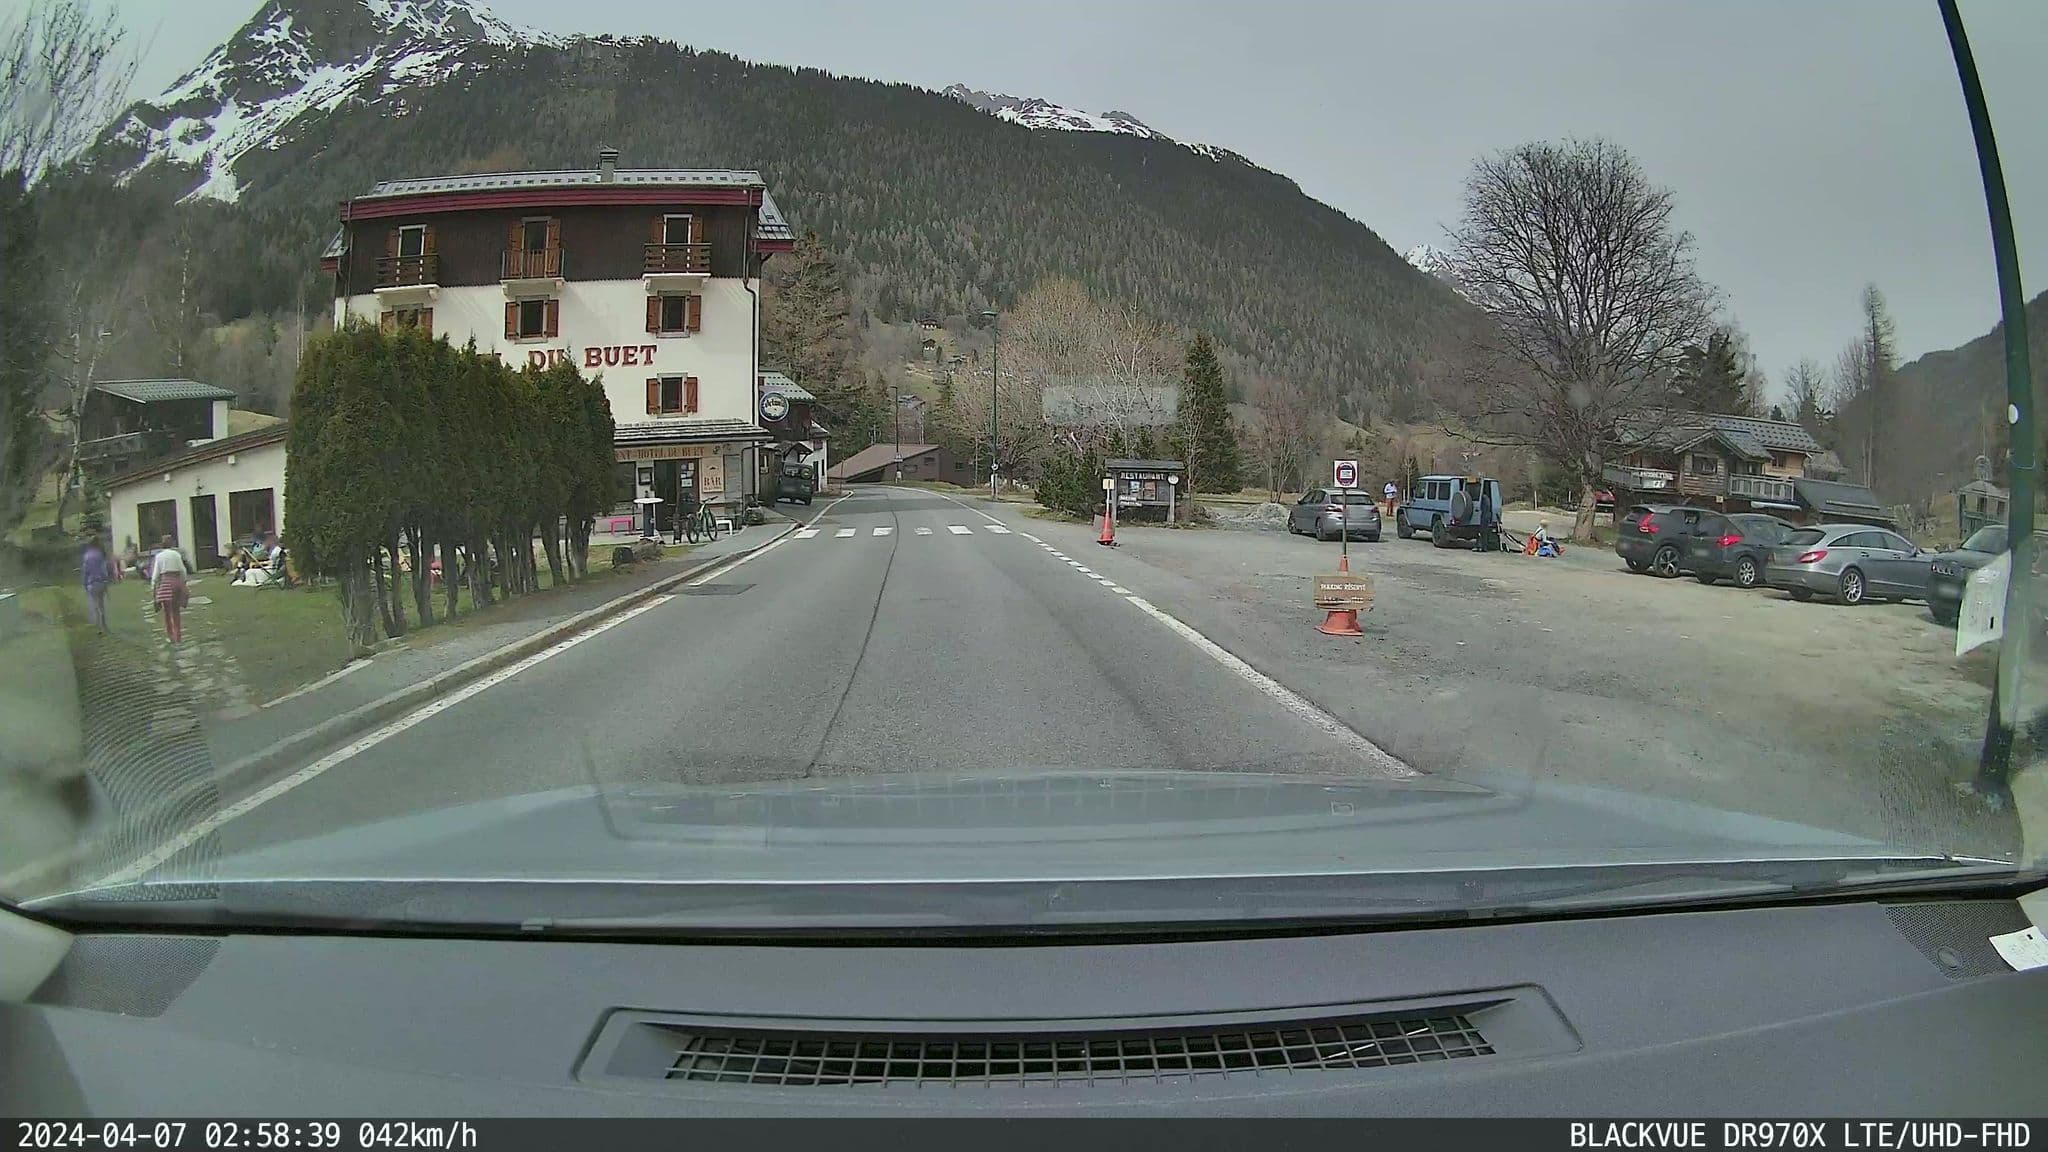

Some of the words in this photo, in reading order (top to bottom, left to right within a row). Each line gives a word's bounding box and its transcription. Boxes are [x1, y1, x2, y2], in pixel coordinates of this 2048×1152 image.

[584, 344, 658, 369] BUET
[682, 446, 705, 457] BUET
[704, 476, 721, 486] BAR
[1120, 472, 1165, 480] RESTAURANT
